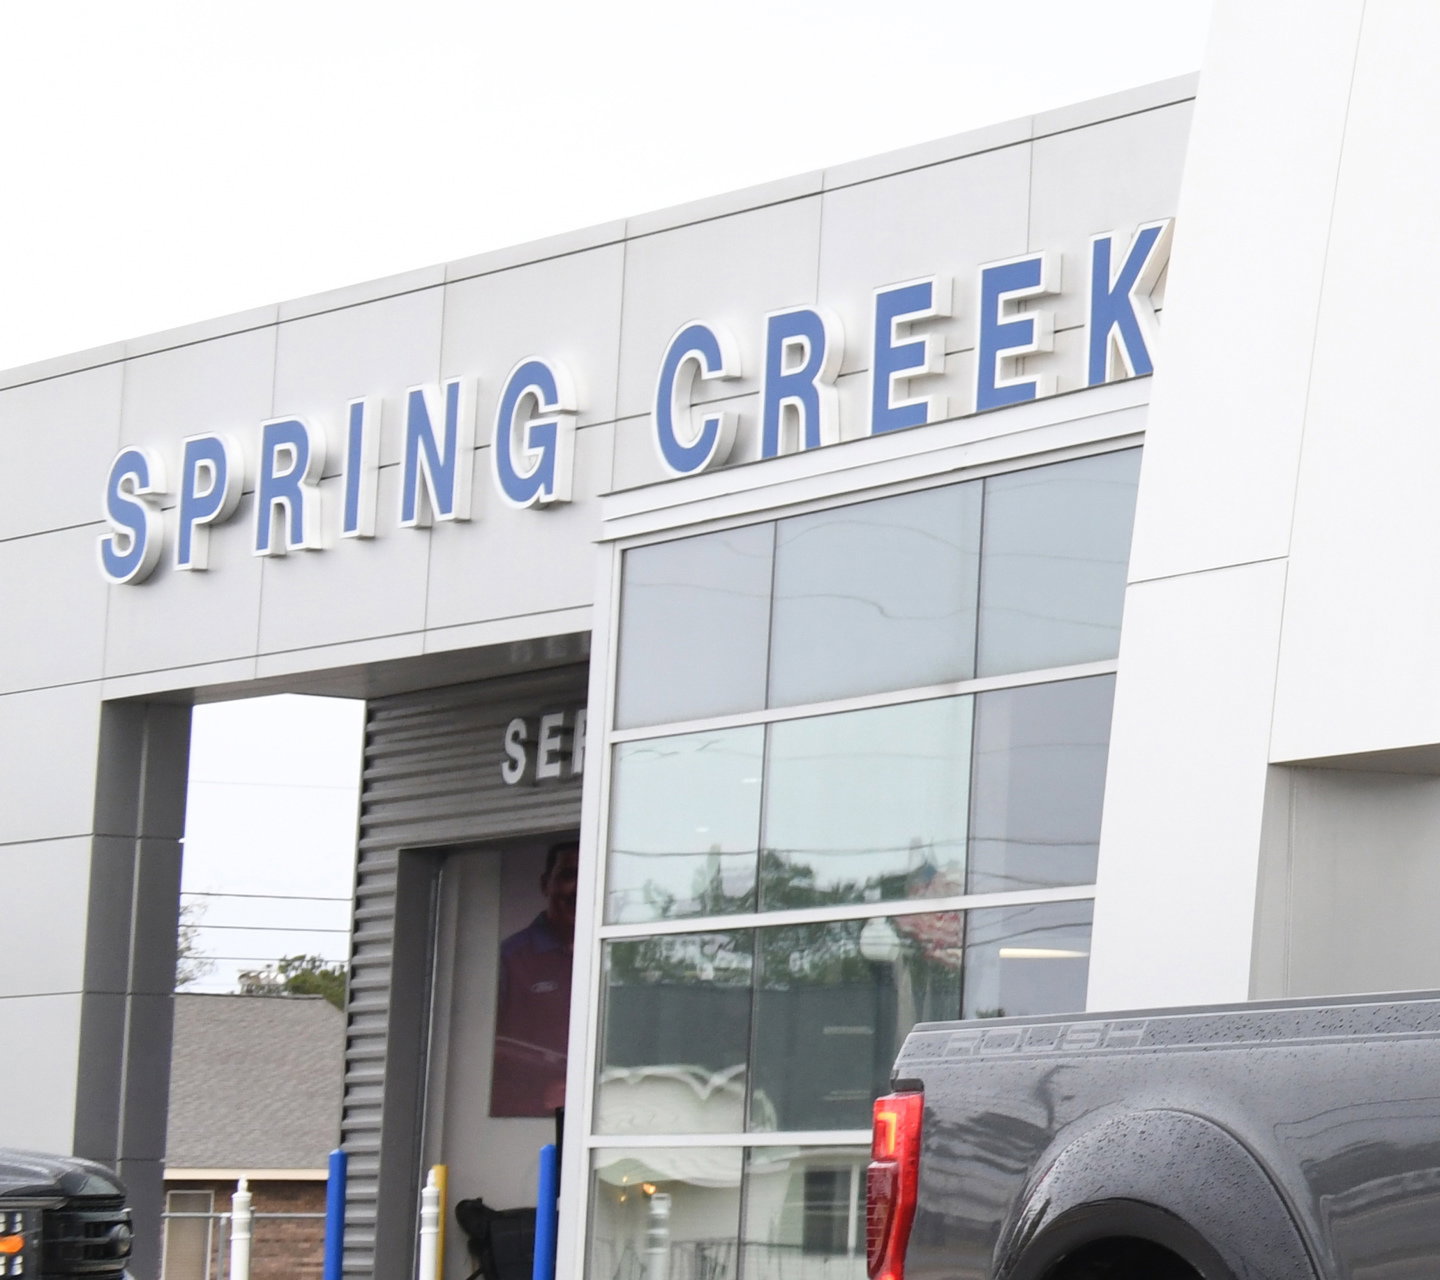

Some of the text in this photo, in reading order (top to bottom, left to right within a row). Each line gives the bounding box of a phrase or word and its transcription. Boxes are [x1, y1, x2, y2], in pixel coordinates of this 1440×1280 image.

[96, 218, 1174, 586] SPRING CREEK
[943, 1020, 1149, 1058] ROUSH
